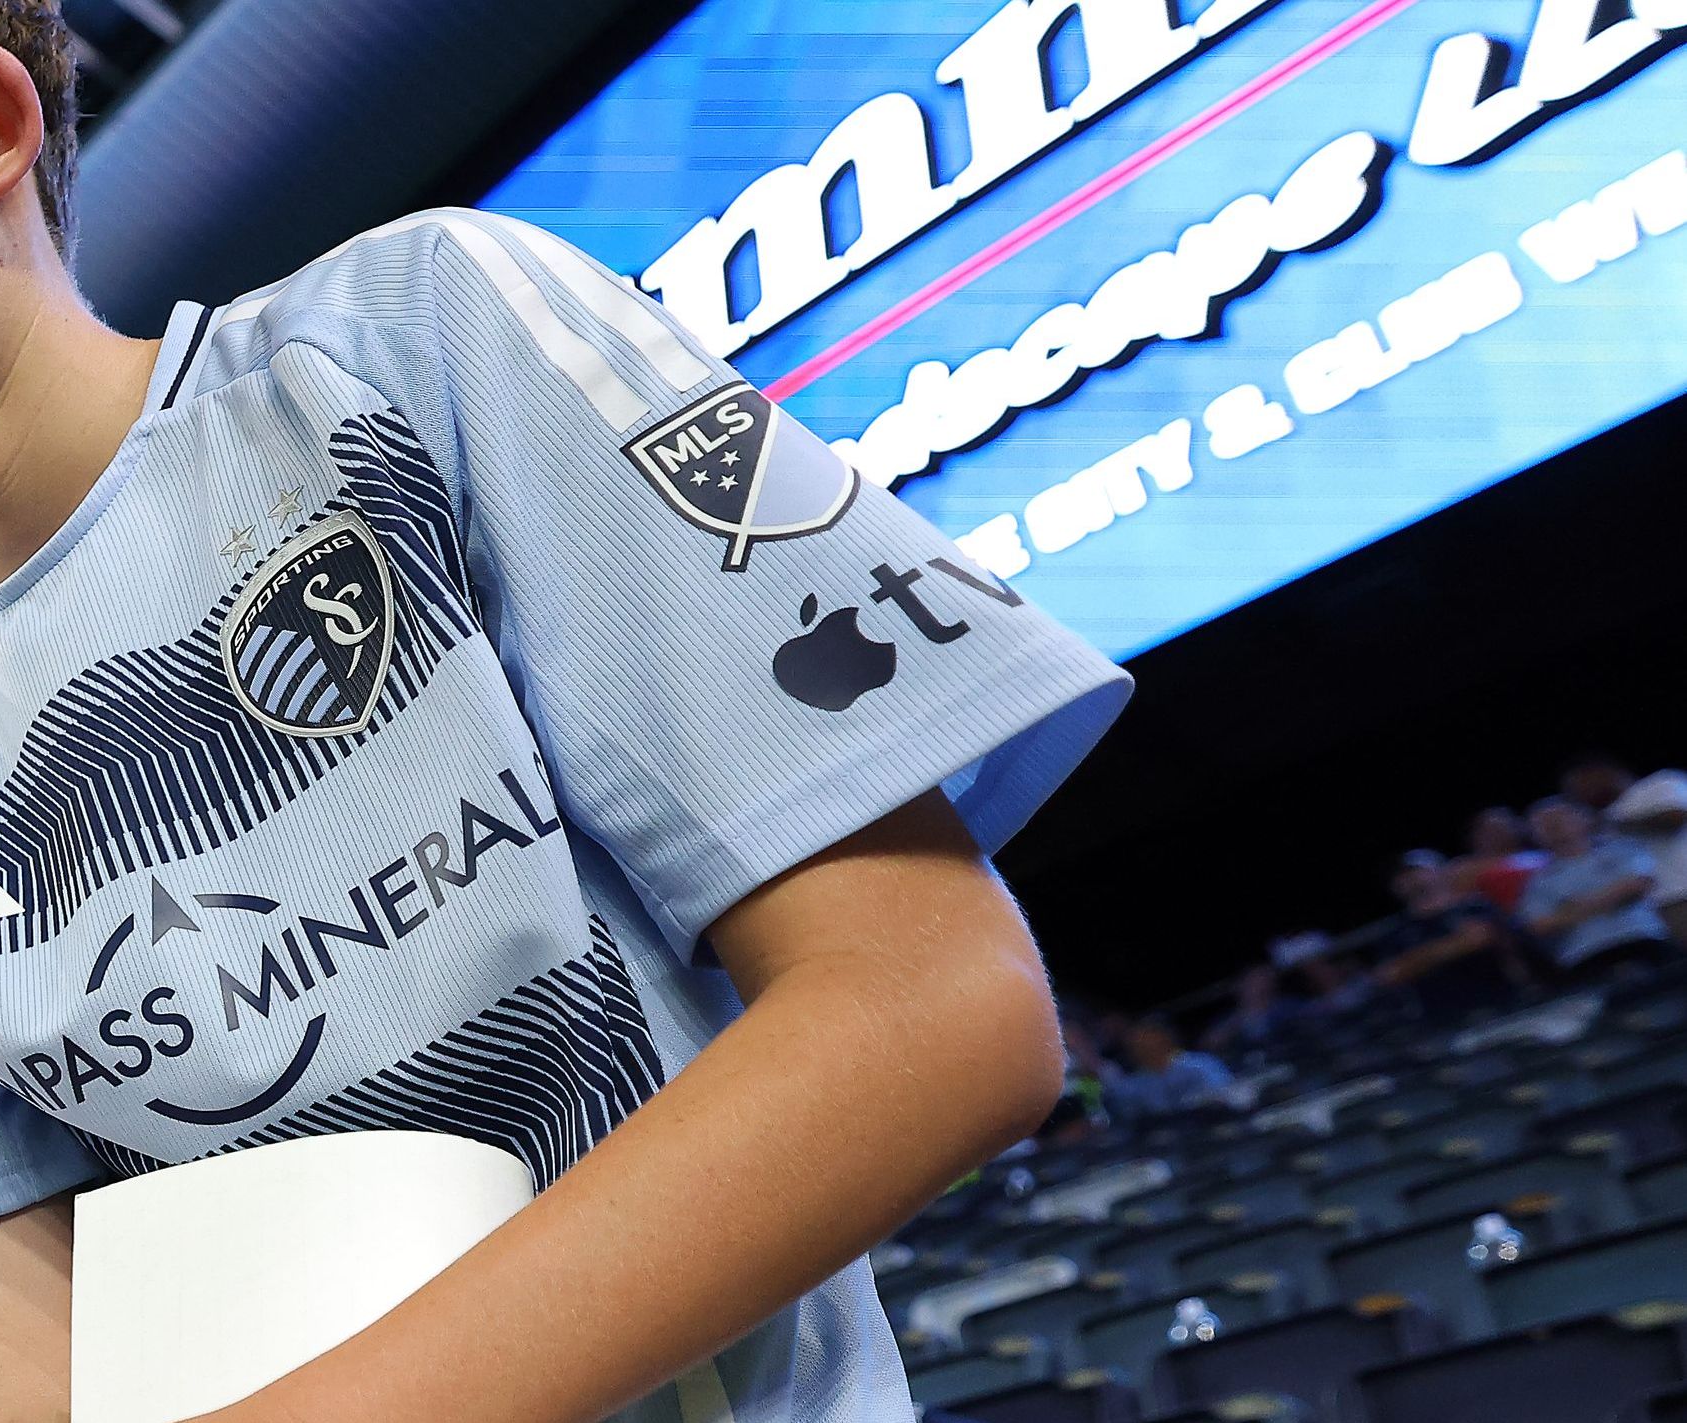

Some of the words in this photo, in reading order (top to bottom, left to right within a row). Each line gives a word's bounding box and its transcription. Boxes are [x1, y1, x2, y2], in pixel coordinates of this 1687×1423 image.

[653, 401, 755, 475] MLS
[232, 534, 355, 655] SPORTING
[217, 752, 562, 1033] MINERAL
